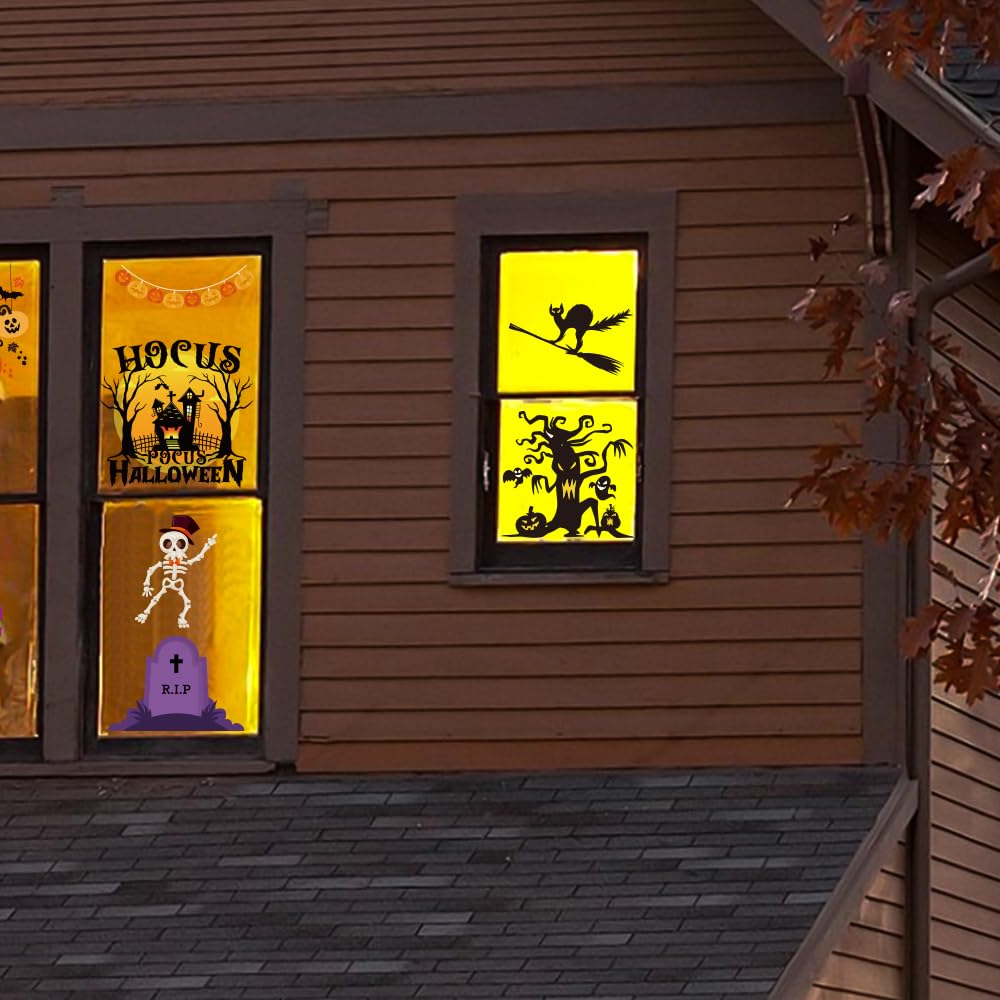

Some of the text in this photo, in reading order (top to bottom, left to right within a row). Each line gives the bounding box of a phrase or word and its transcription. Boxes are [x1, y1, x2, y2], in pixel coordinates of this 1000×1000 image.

[112, 339, 241, 374] HOCUS
[147, 450, 206, 465] POCUS
[109, 459, 244, 487] HALLOWEEN
[161, 684, 191, 695] R.I.P
